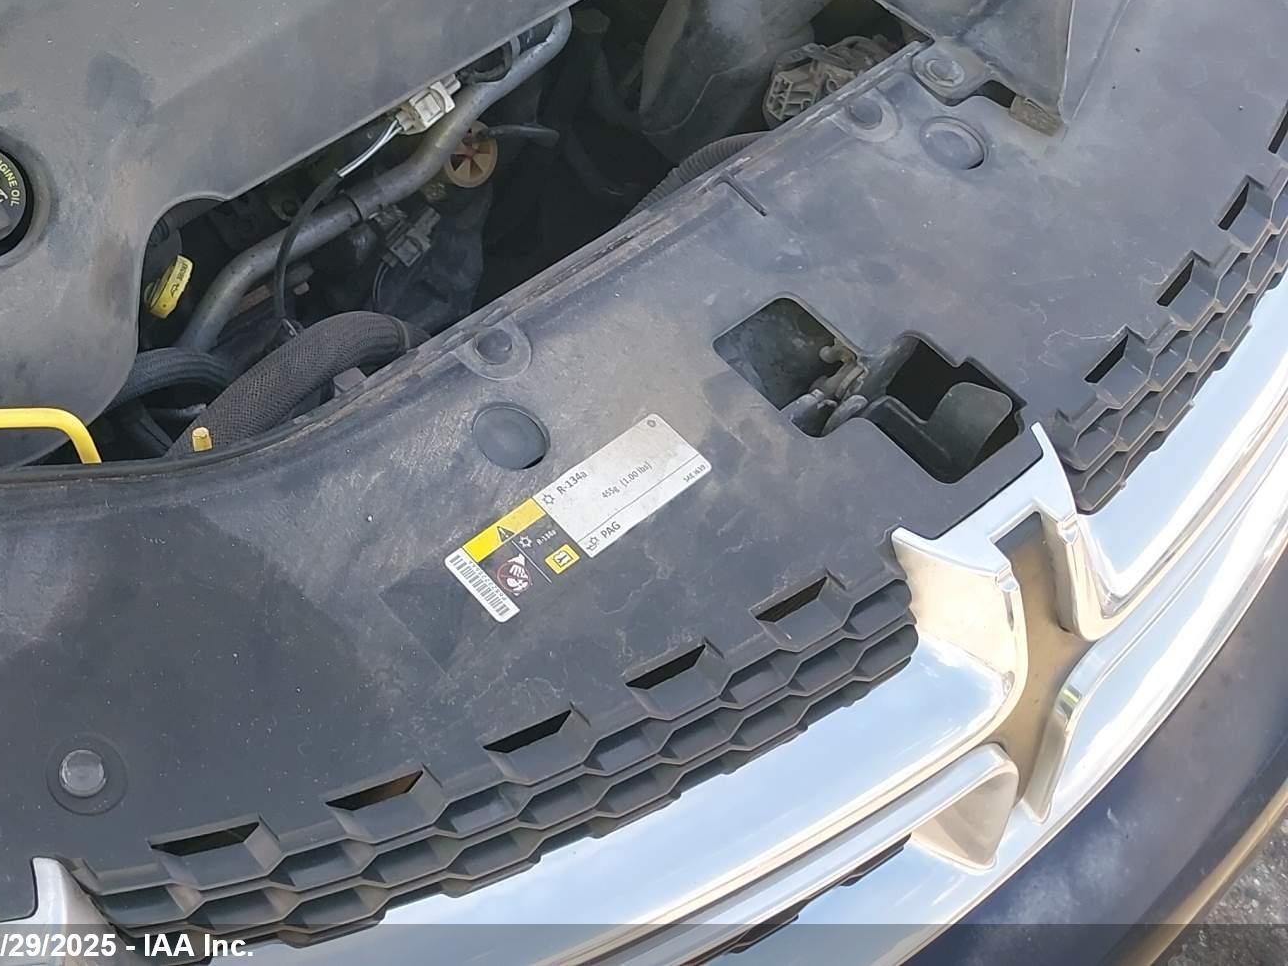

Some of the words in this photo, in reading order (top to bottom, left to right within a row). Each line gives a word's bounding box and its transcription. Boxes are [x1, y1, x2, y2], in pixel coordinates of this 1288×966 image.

[10, 189, 20, 207] OIL
[556, 470, 588, 495] R-134a
[600, 521, 622, 539] PAG
